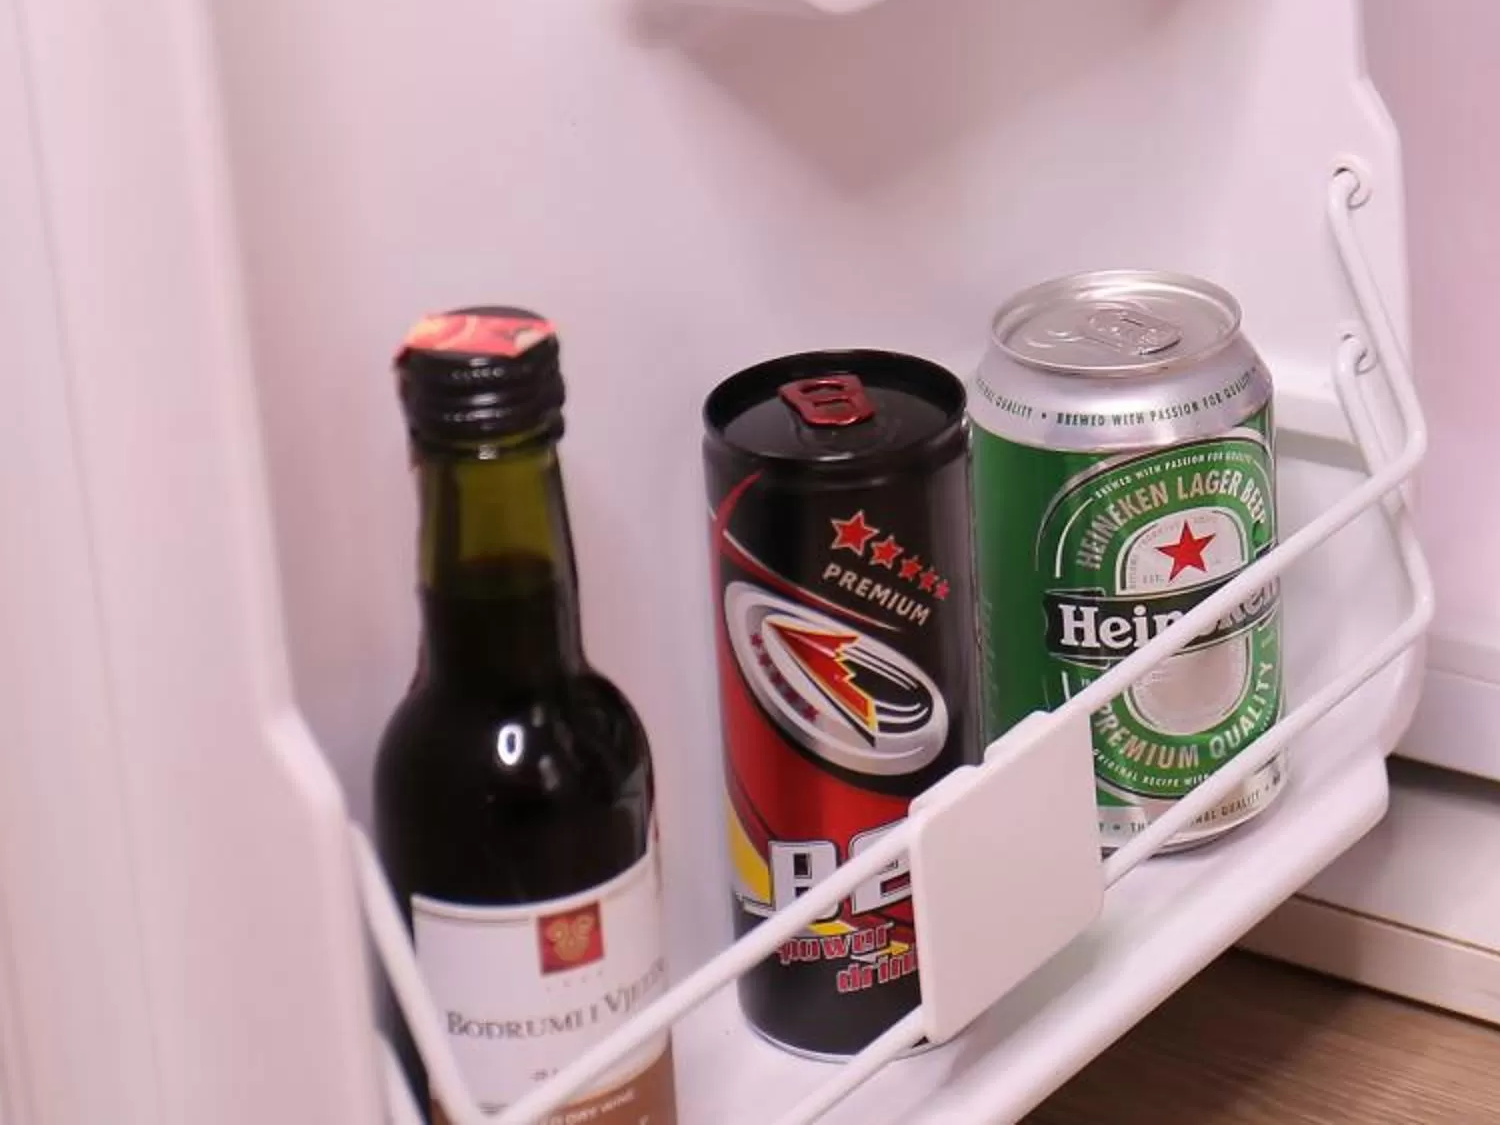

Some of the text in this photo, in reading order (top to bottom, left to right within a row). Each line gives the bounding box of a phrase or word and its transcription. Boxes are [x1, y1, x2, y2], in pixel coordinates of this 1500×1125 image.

[1056, 412, 1106, 427] BREWED
[1112, 411, 1145, 427] WITH
[1150, 401, 1199, 422] PASSION
[1202, 391, 1222, 410] FOR
[1164, 454, 1205, 472] PASSION
[1075, 480, 1170, 571] HEINEKEN
[1177, 469, 1244, 501] LAGER
[822, 562, 931, 626] PREMIUM
[1209, 661, 1274, 760] QUALITY
[1143, 774, 1180, 788] RECIPE
[446, 1008, 583, 1040] BODRUMI
